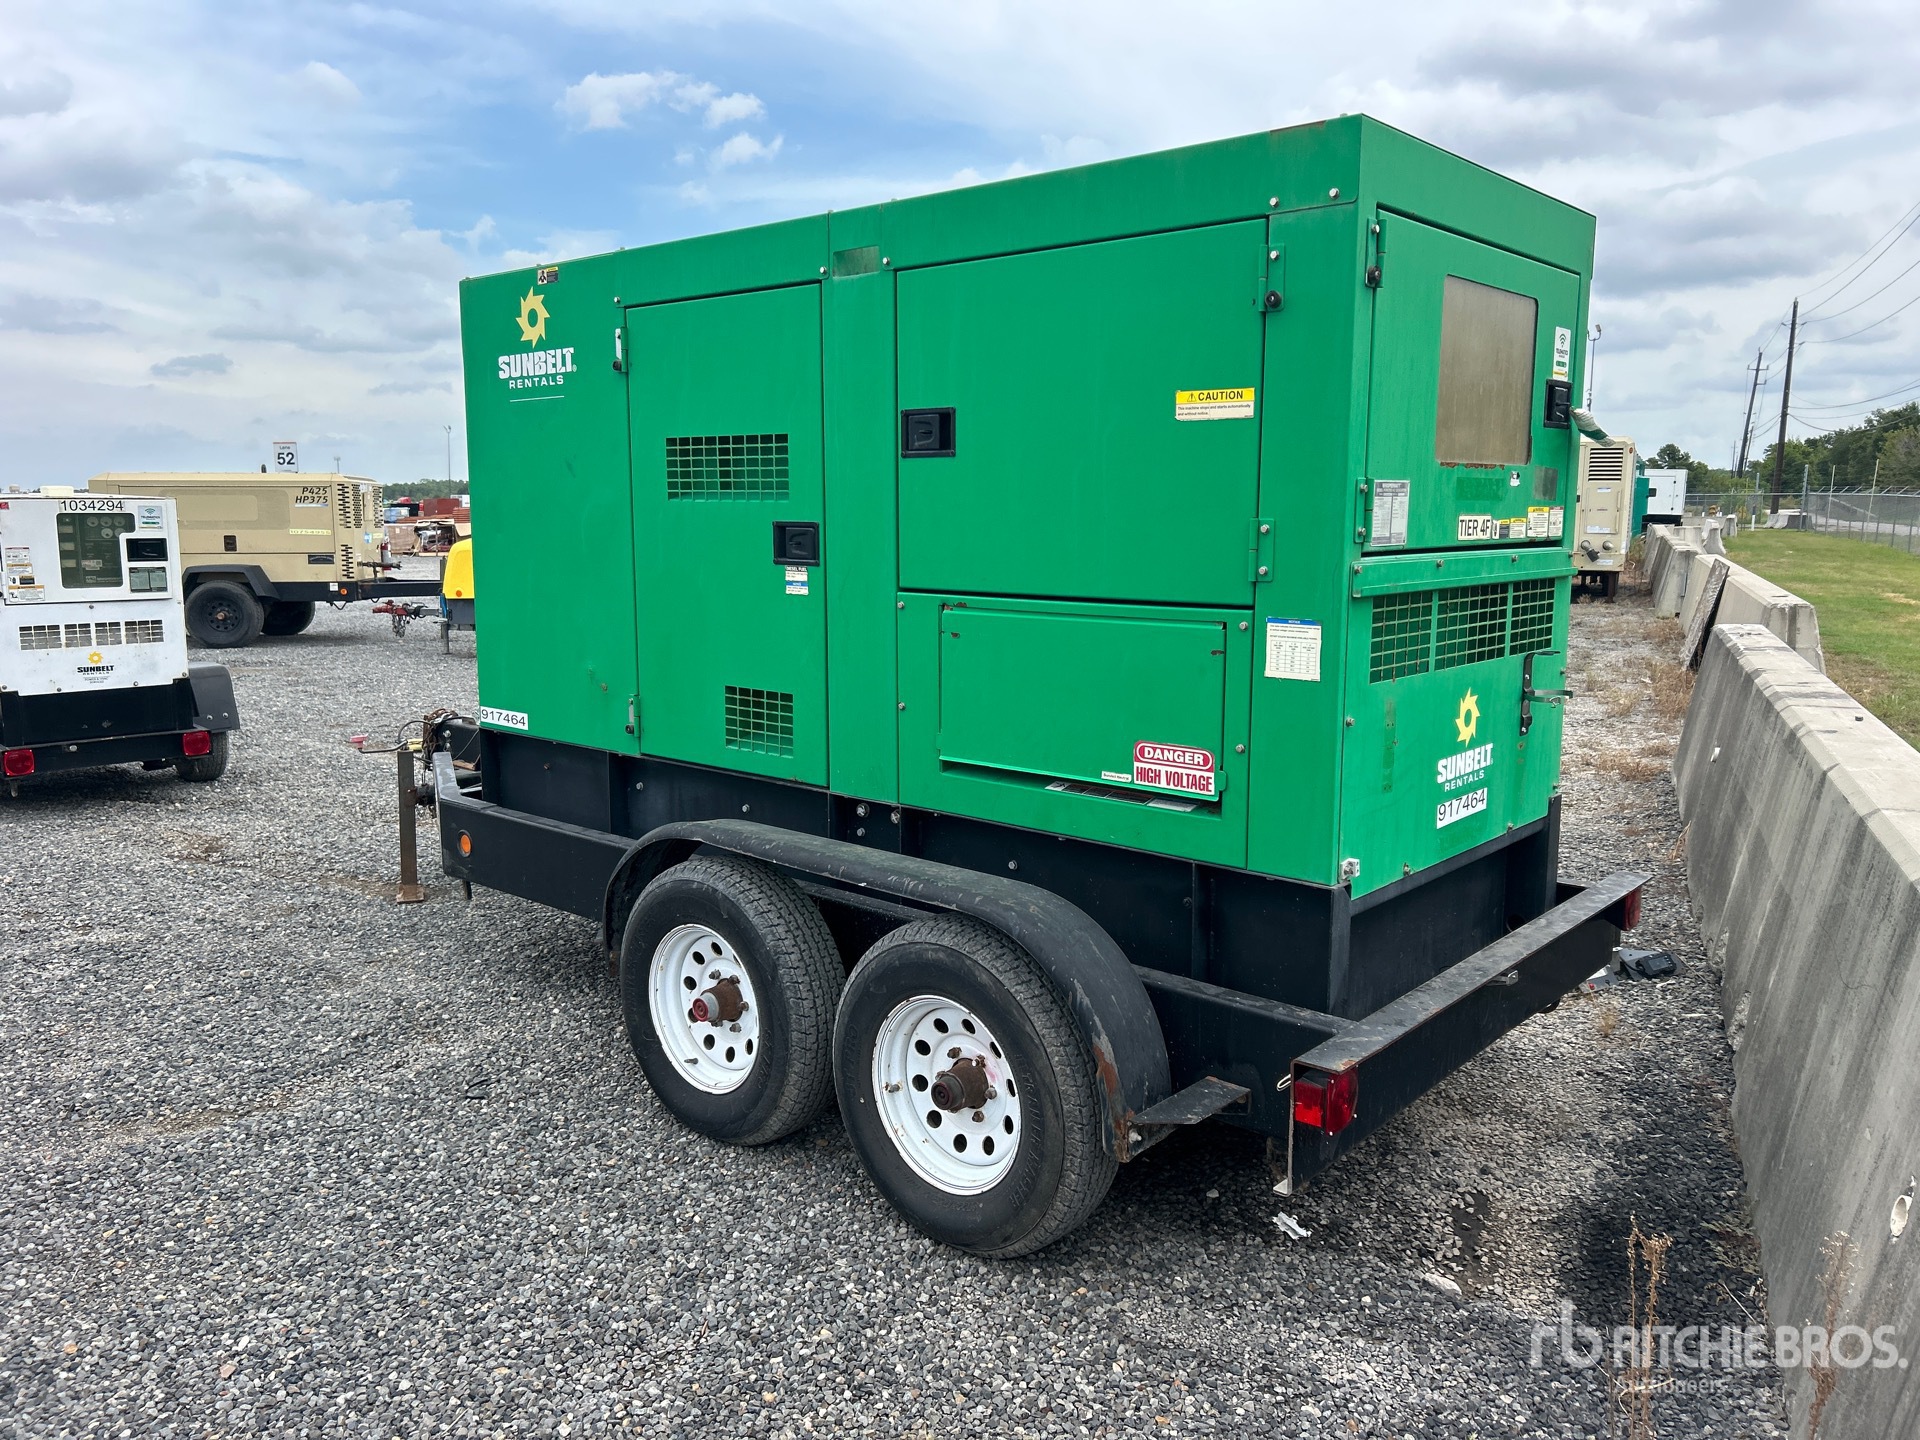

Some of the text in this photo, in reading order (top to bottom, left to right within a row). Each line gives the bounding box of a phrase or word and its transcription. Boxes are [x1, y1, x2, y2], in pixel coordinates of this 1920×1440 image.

[498, 347, 575, 379] SUNBELT
[509, 375, 564, 389] RENTALS
[1197, 390, 1243, 402] CAUTION
[277, 452, 296, 466] 52
[301, 486, 328, 495] P425
[60, 500, 124, 511] 1034294
[295, 496, 329, 504] HP375
[1460, 519, 1479, 537] TIER
[1480, 518, 1491, 536] 4F
[77, 665, 114, 673] SUNBELT
[481, 709, 526, 726] 917464
[1144, 746, 1204, 766] DANGER
[1437, 742, 1493, 784] SUNBELT
[1136, 766, 1212, 792] HIGH VOLTAGE
[1444, 770, 1485, 792] RENTALS
[1438, 789, 1486, 822] 917464
